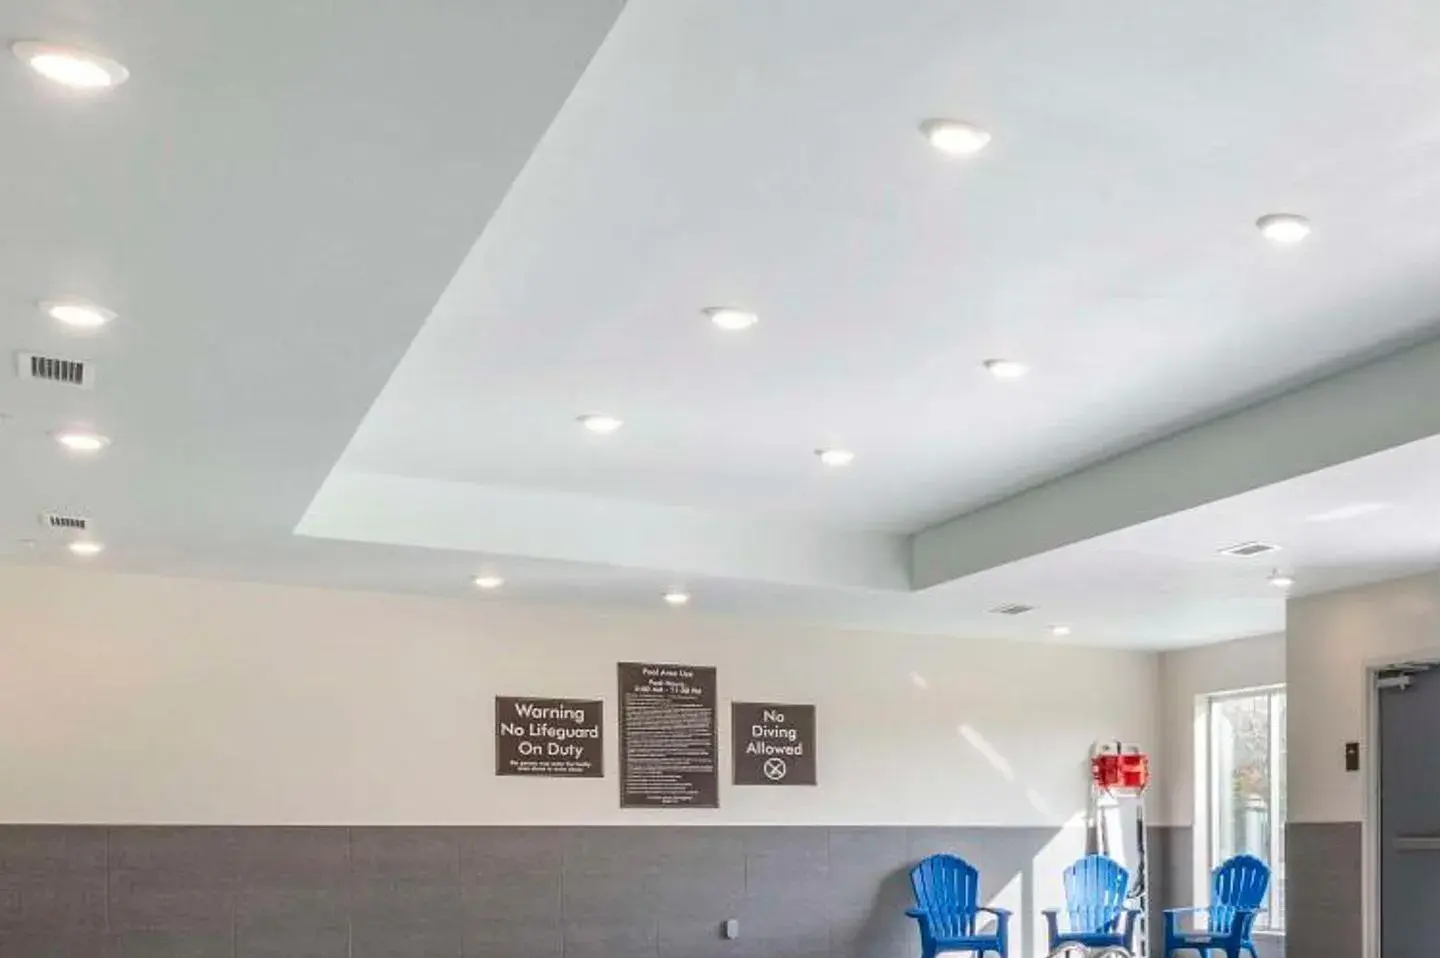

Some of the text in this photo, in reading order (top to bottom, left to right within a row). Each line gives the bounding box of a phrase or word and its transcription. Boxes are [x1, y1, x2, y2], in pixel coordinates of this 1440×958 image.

[514, 702, 585, 724] Warning
[763, 709, 784, 723] No
[500, 722, 599, 740] No Lifeguard
[752, 725, 797, 741] Diving
[518, 740, 584, 760] On Duty
[745, 741, 803, 755] Allowed
